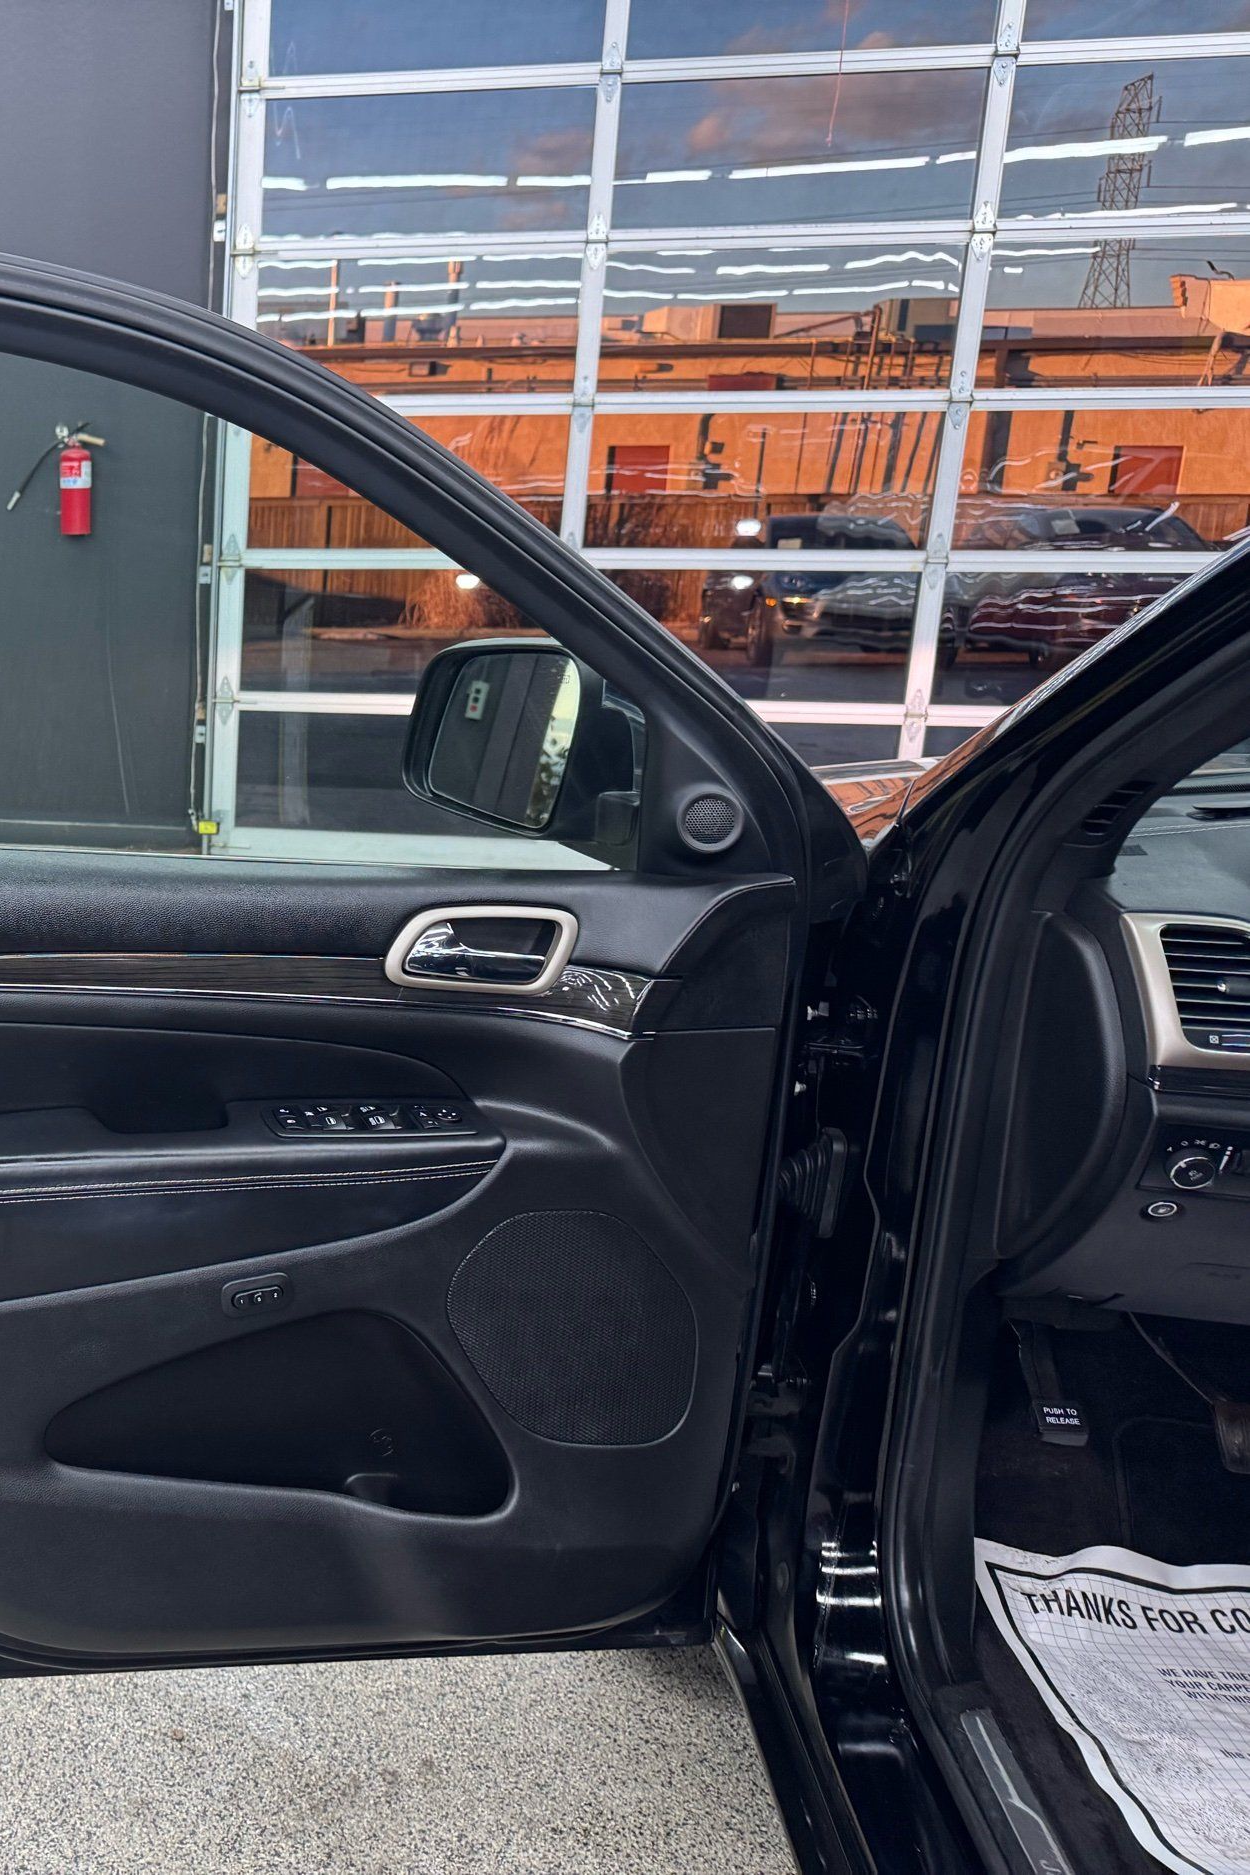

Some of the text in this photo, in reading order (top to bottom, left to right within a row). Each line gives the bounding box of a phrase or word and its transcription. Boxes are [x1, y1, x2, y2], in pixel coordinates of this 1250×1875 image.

[1042, 1406, 1078, 1416] PUSH TO
[1045, 1416, 1082, 1426] RELEASE
[1020, 1587, 1138, 1630] THANKS
[1140, 1604, 1209, 1635] FOR
